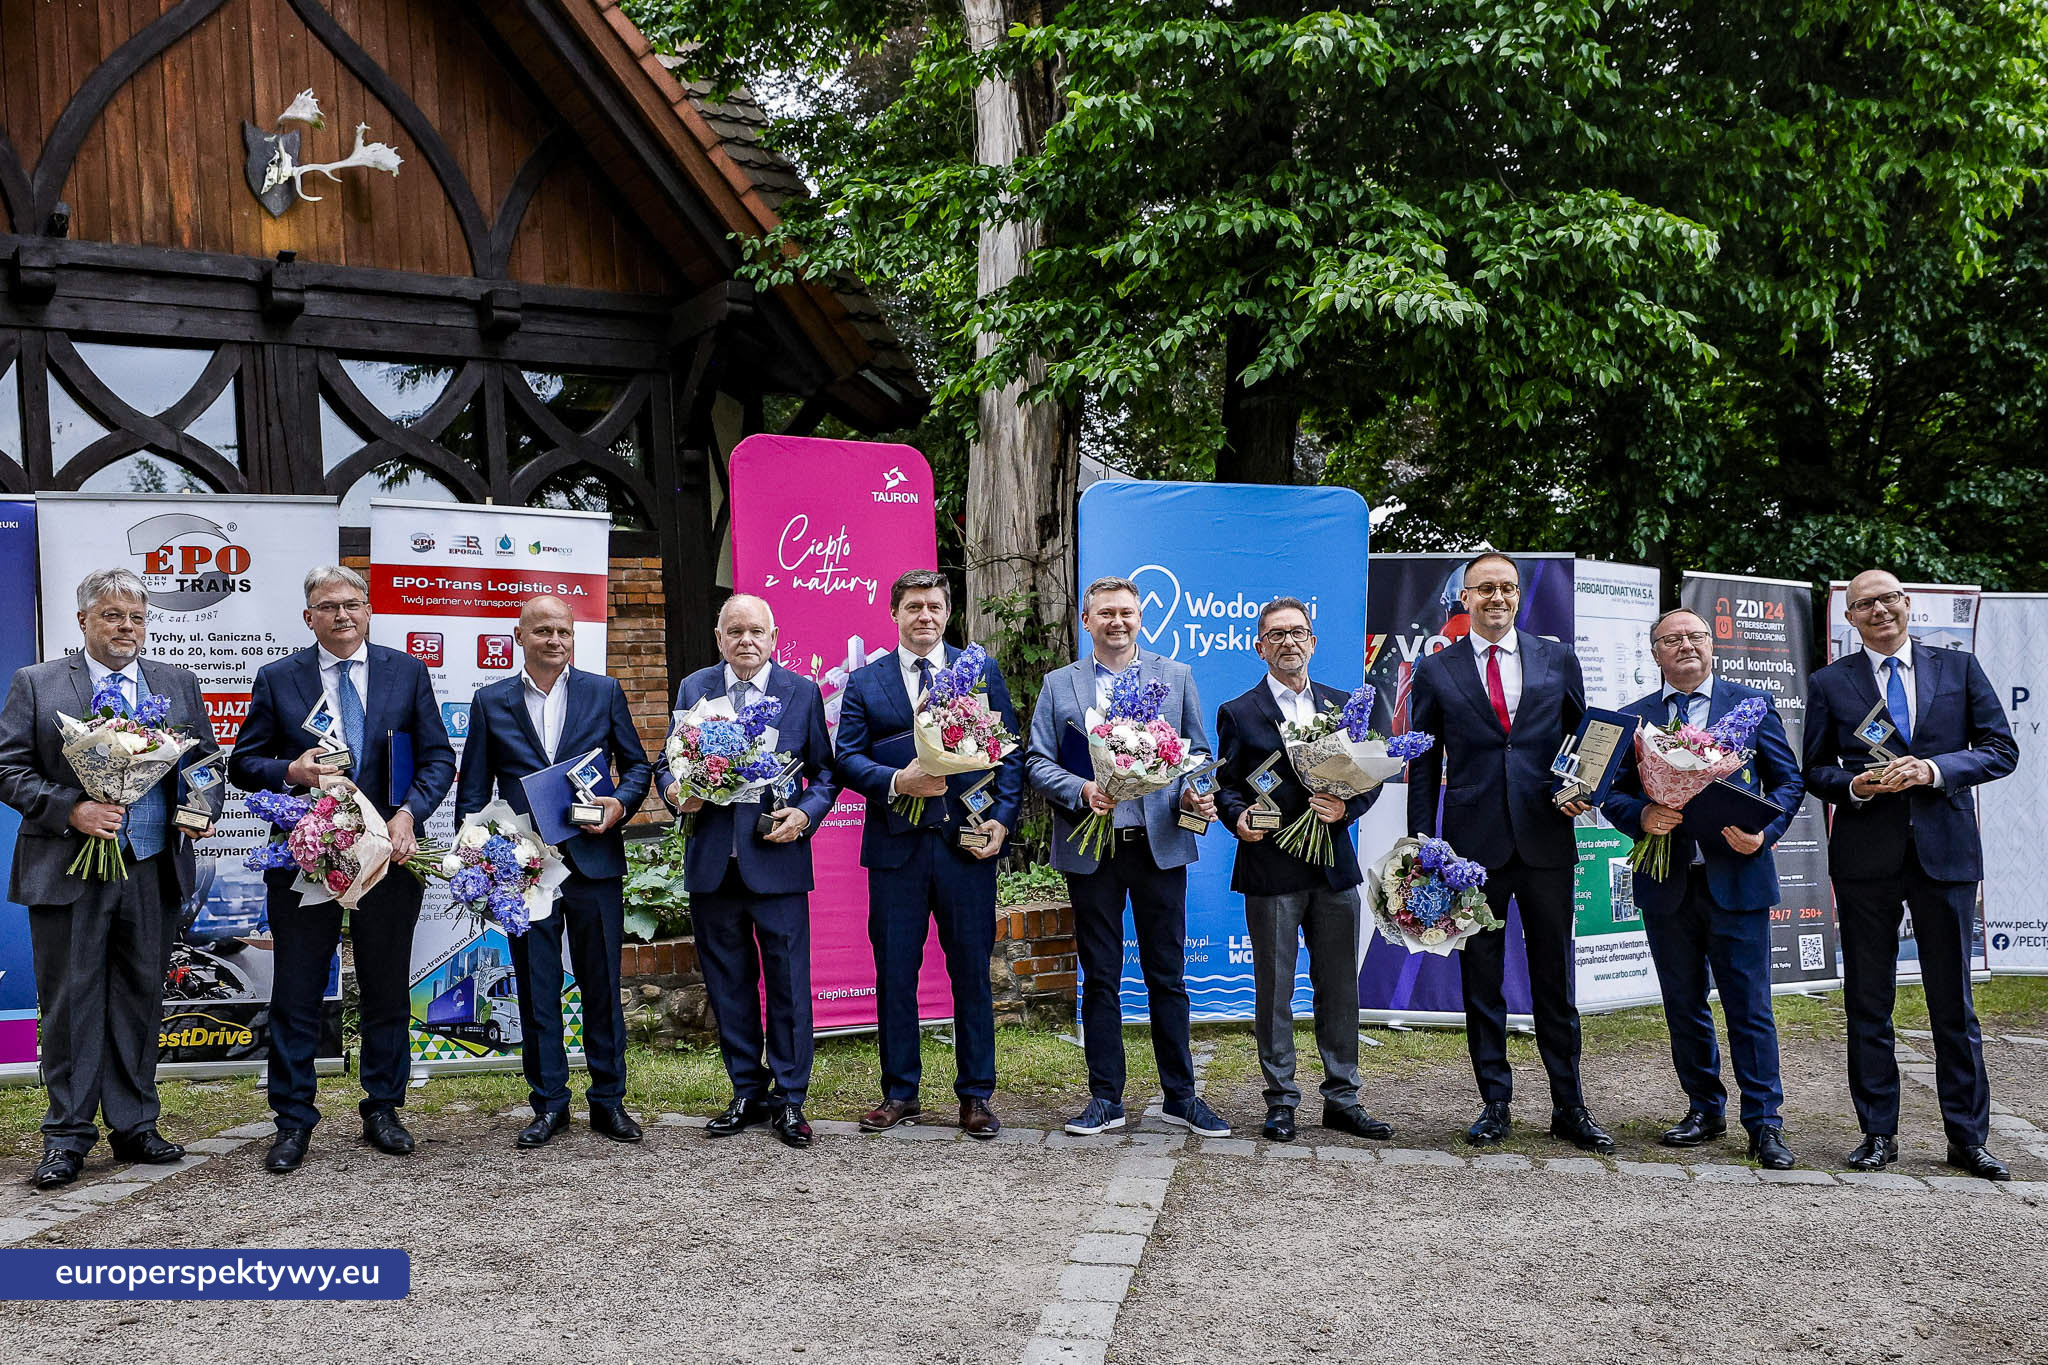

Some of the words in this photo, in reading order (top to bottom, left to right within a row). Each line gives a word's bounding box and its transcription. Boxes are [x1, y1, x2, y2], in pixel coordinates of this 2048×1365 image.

[871, 491, 919, 504] TAURON
[448, 548, 484, 556] EPORAIL
[143, 545, 251, 575] EPO
[176, 579, 252, 593] TRANS
[392, 576, 483, 591] EPO-Trans
[487, 580, 553, 594] Logistic
[556, 583, 589, 597] S.A.
[765, 574, 780, 587] z
[792, 562, 878, 605] natury
[1642, 588, 1655, 600] S.A.
[401, 595, 424, 605] Twój
[425, 596, 462, 607] partner
[195, 610, 219, 622] 1987
[1735, 599, 1785, 620] ZDI24
[1735, 619, 1785, 632] CYBERSECURITY
[150, 633, 186, 643] Tychy,
[190, 633, 204, 642] ul.
[207, 633, 261, 642] Ganiczna
[264, 633, 276, 643] 5,
[1743, 632, 1786, 643] OUTSOURCING
[151, 647, 166, 656] 18
[169, 647, 184, 656] do
[188, 647, 205, 658] 20,
[209, 647, 237, 656] kom.
[241, 646, 263, 656] 608
[267, 646, 288, 656] 675
[411, 639, 440, 653] 35
[170, 661, 246, 672] po-serwis.pl
[482, 657, 509, 667] 410
[1722, 656, 1744, 672] pod
[1773, 695, 1805, 709] anek.
[436, 811, 454, 819] syst
[820, 817, 863, 828] ozwiązania
[214, 827, 266, 838] lowanie
[1579, 853, 1596, 861] wanie
[419, 914, 432, 922] cja
[1769, 909, 1792, 921] 24/7
[1799, 908, 1823, 919] 250+
[1985, 919, 2048, 932] www.pec.ty
[1575, 944, 1595, 955] niamy
[1595, 942, 1619, 953] naszym
[1619, 939, 1644, 949] klientom
[2012, 935, 2048, 950] /PECT
[409, 929, 477, 983] .epo-trans.com.pl
[1183, 951, 1209, 966] yskie
[1229, 950, 1255, 964] WO
[1575, 953, 1608, 967] cjonalność
[1608, 949, 1648, 963] oferowanych
[1594, 967, 1648, 982] www.carbo.com.pl
[818, 986, 877, 1001] cieplo.tauro
[159, 1027, 253, 1048] estDrive
